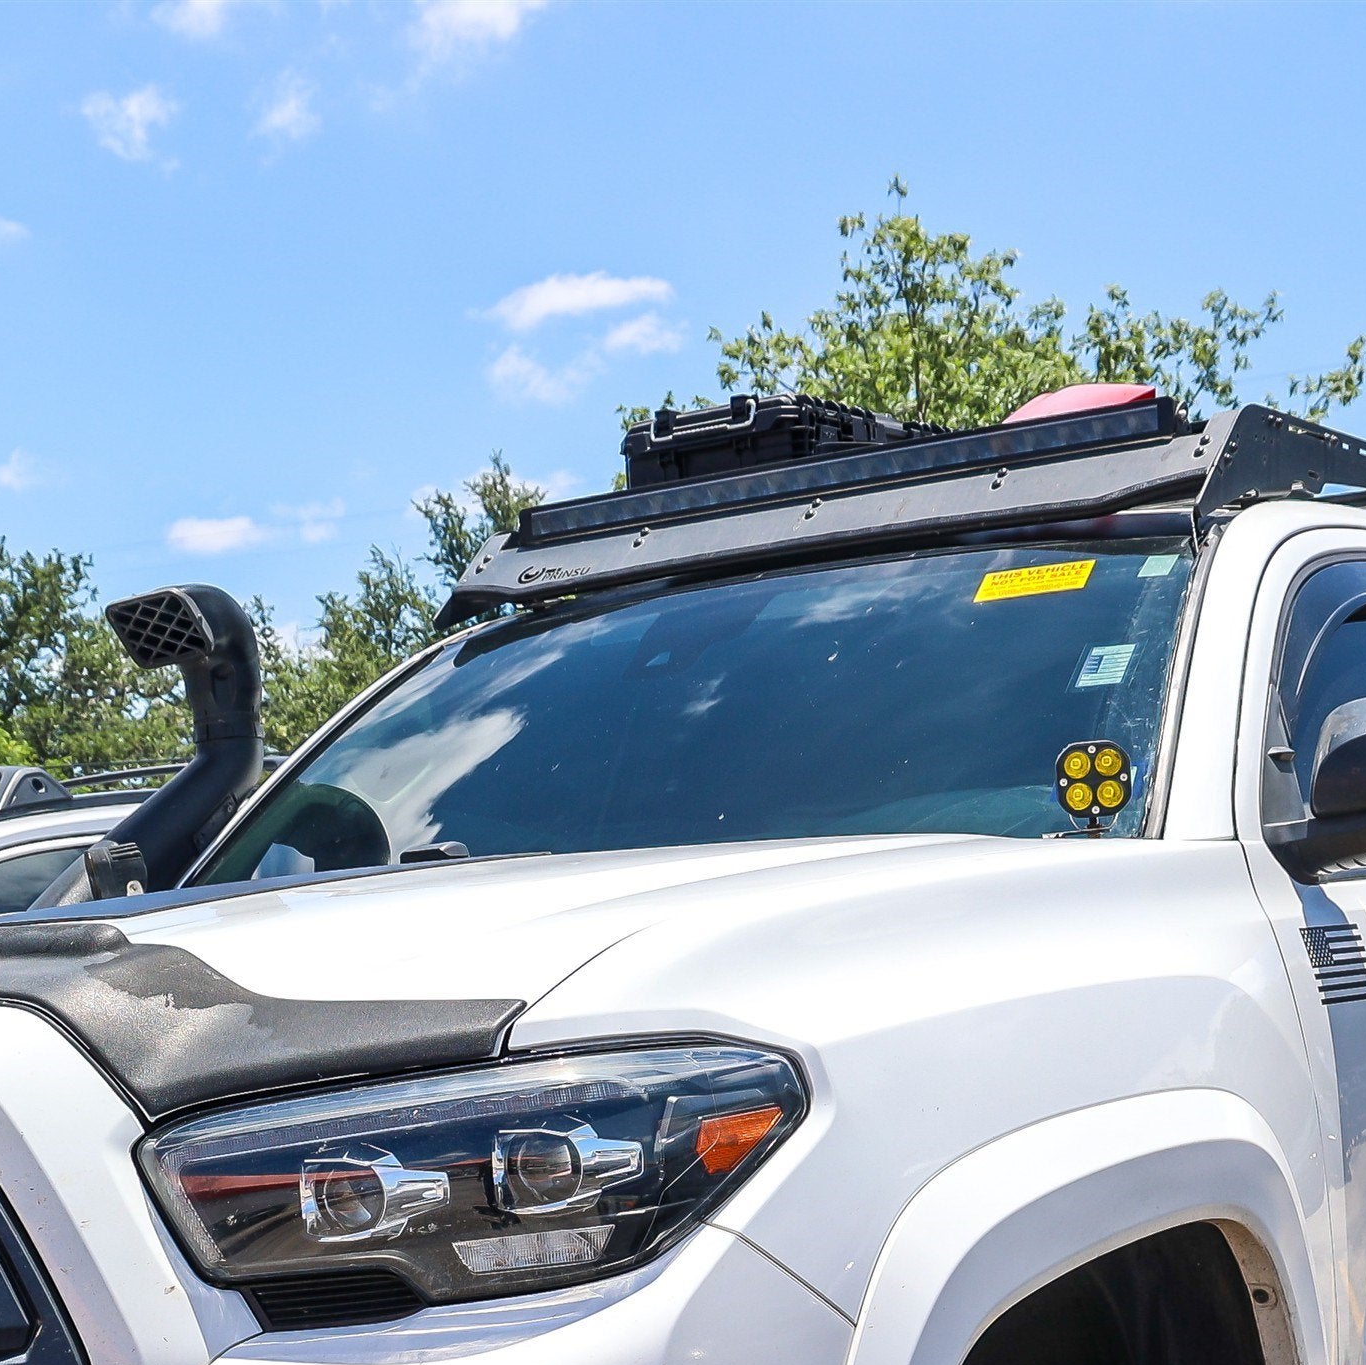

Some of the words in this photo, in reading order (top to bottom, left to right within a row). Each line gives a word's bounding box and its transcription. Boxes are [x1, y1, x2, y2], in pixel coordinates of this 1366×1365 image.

[541, 566, 591, 581] PRINSU
[990, 579, 1016, 587] NOT
[1019, 574, 1045, 583] FOR
[1049, 569, 1083, 579] SALE
[991, 571, 1023, 580] THIS
[1028, 562, 1089, 576] VEHICLE
